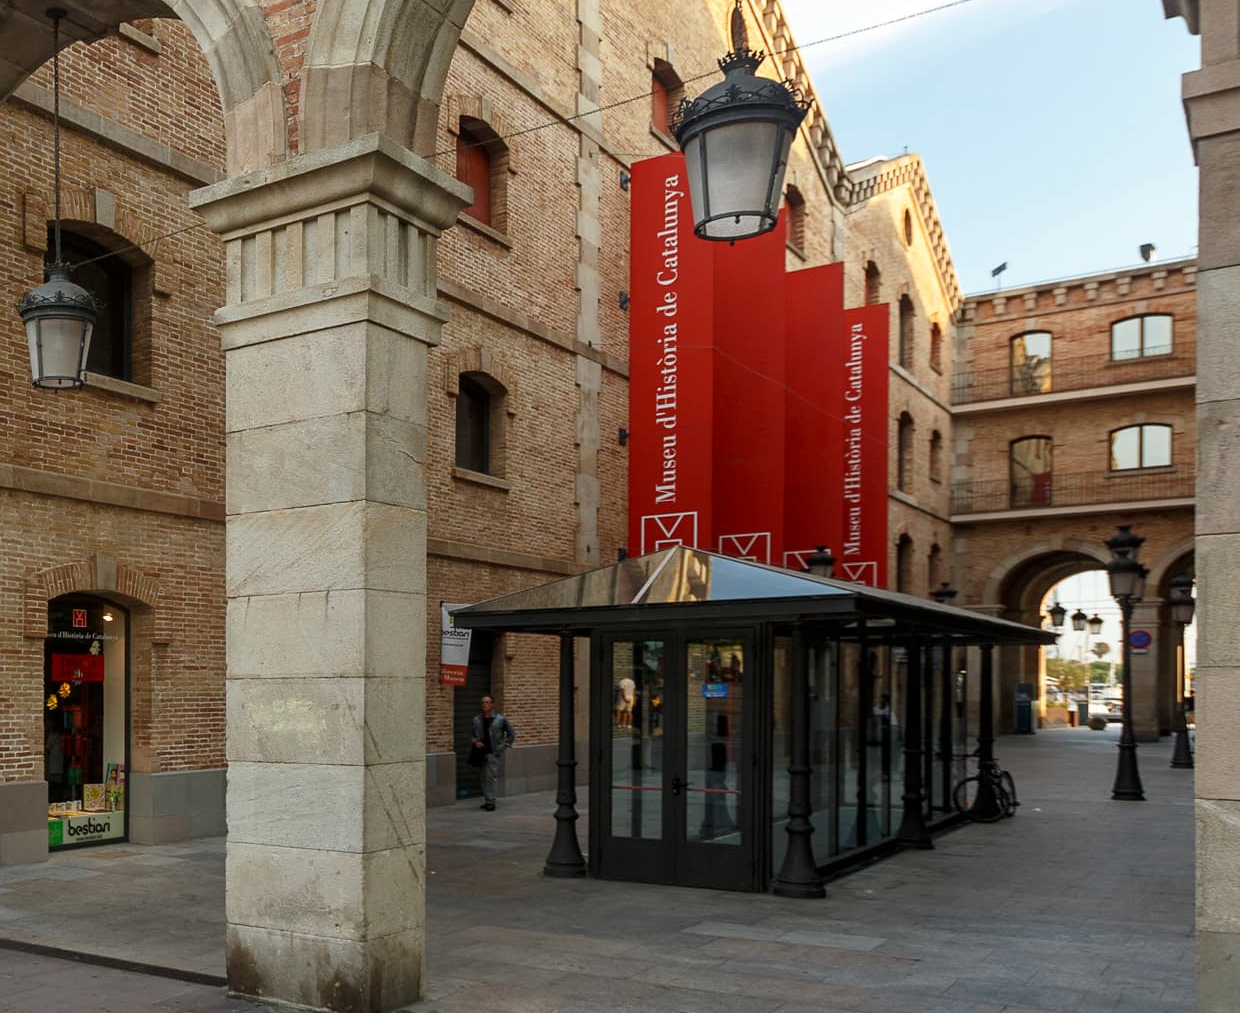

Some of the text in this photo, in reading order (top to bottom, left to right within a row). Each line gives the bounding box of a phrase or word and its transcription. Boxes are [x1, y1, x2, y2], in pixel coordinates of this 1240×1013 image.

[655, 174, 685, 505] Museu d'Història de Catalunya
[843, 323, 867, 556] Museu d'Història de Catalunya
